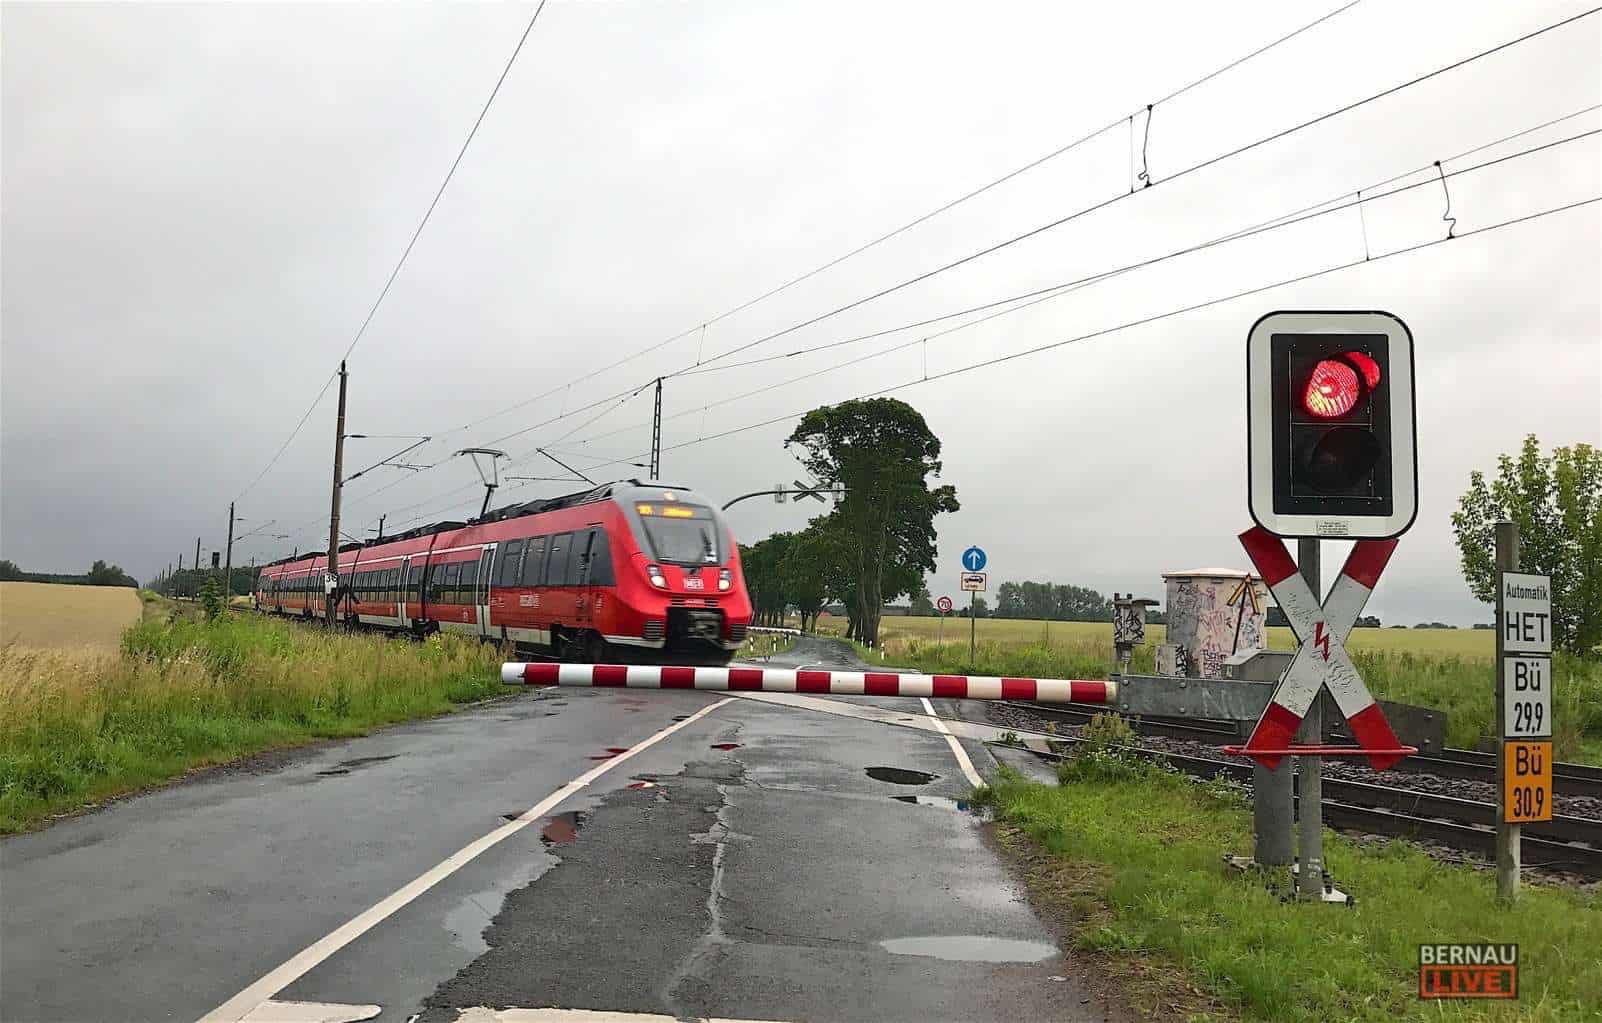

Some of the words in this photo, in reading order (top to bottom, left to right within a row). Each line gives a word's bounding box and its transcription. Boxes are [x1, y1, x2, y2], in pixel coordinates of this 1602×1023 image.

[940, 600, 950, 609] 70
[1506, 583, 1548, 601] Automatik
[1506, 612, 1548, 642] HET
[1515, 662, 1541, 692] Bü
[1514, 702, 1543, 734] 29,9
[1516, 746, 1542, 776] Bü
[1513, 787, 1544, 818] 30,9
